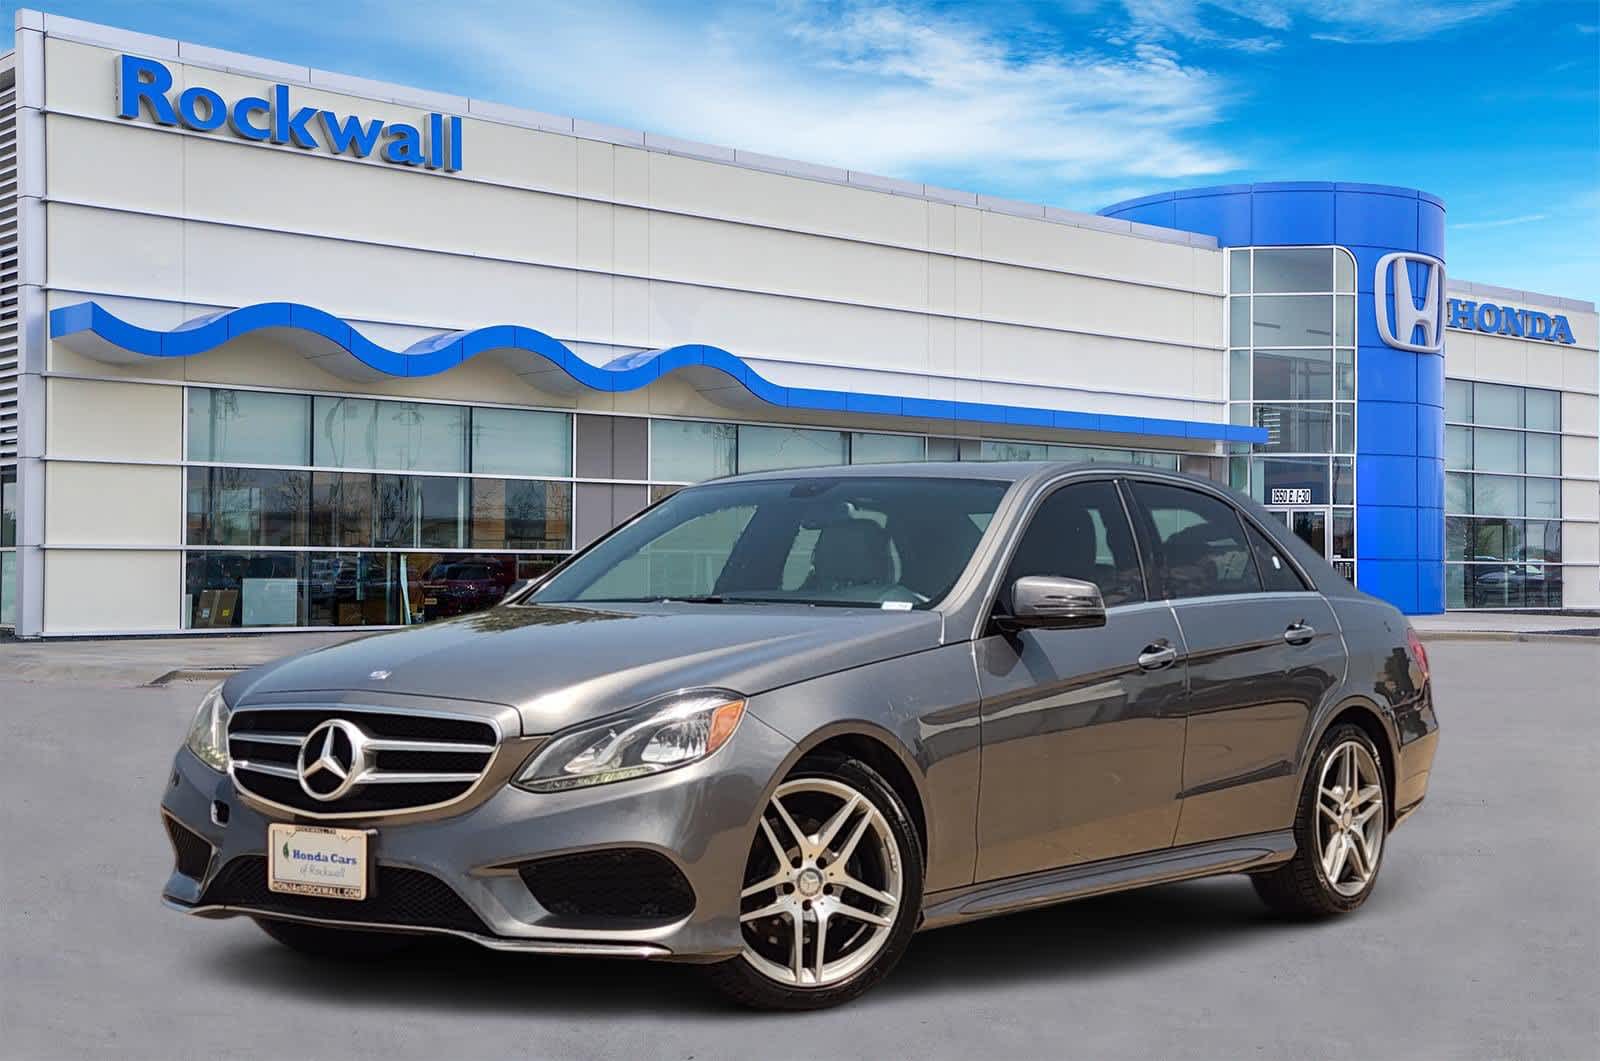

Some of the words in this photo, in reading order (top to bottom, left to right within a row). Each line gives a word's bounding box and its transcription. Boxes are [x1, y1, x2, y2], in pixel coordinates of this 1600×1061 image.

[115, 54, 463, 172] Rockwall
[1446, 298, 1576, 344] HONDA
[1273, 489, 1287, 503] 1550
[292, 849, 329, 863] Honda
[330, 853, 358, 865] Cars
